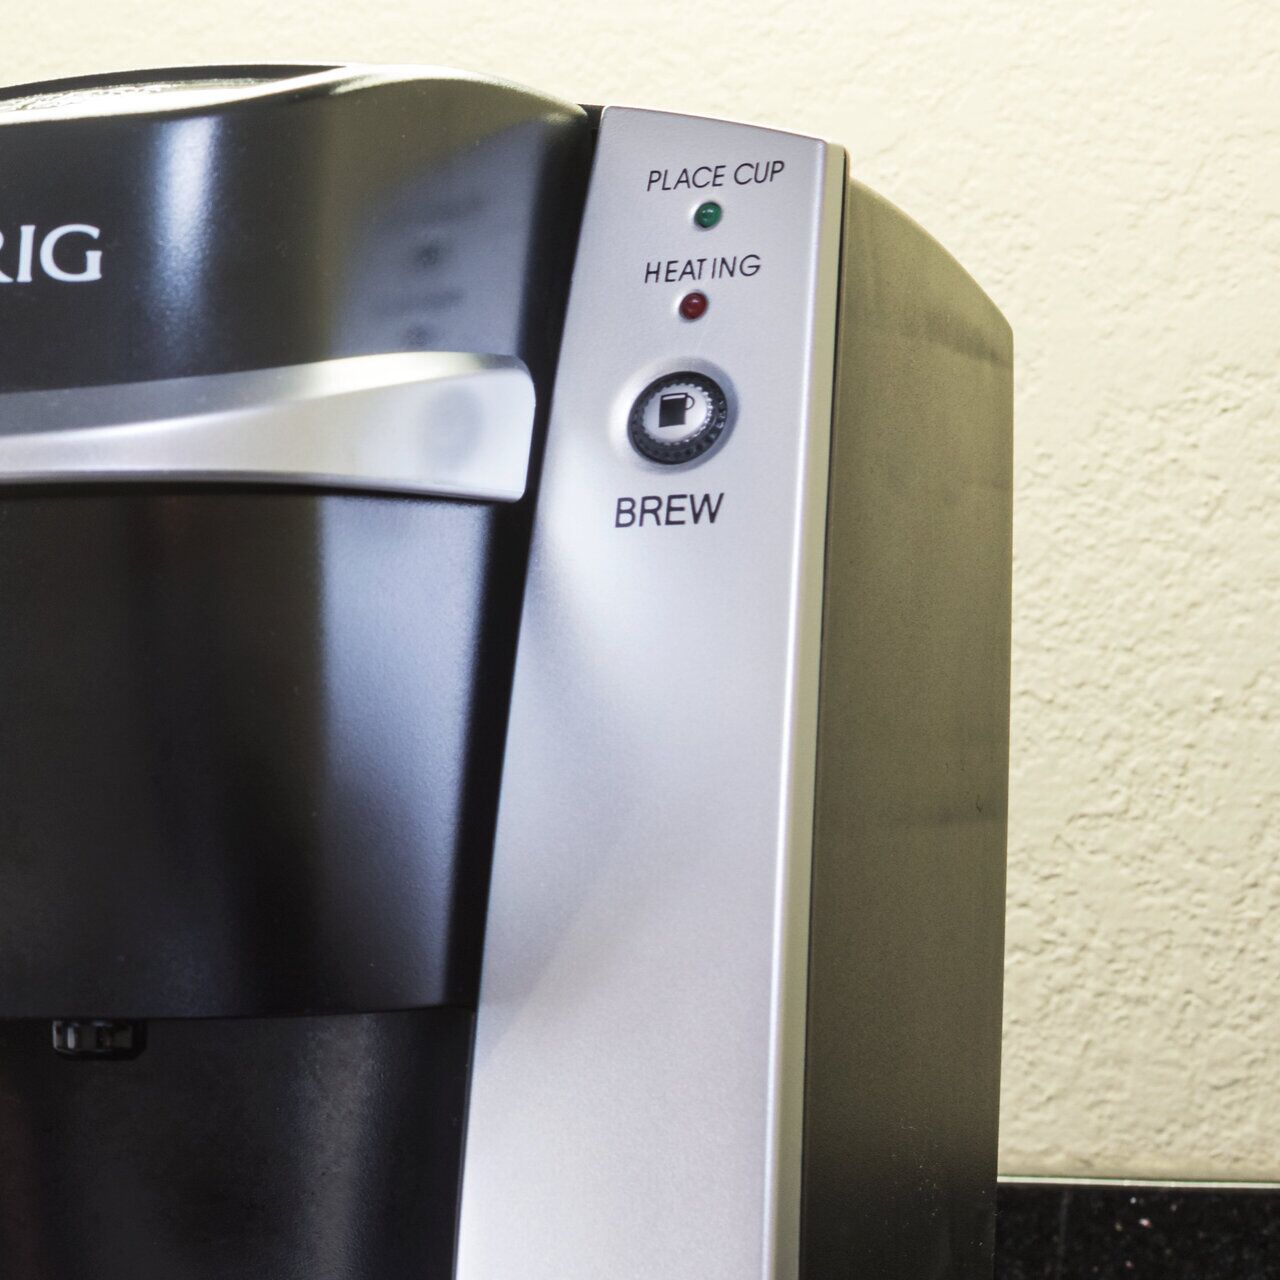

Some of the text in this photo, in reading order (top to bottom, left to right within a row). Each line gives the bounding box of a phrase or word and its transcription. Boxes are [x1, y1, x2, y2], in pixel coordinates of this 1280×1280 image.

[646, 159, 786, 192] PLACE CUP
[644, 253, 762, 284] HEATING
[614, 492, 725, 529] BREW
